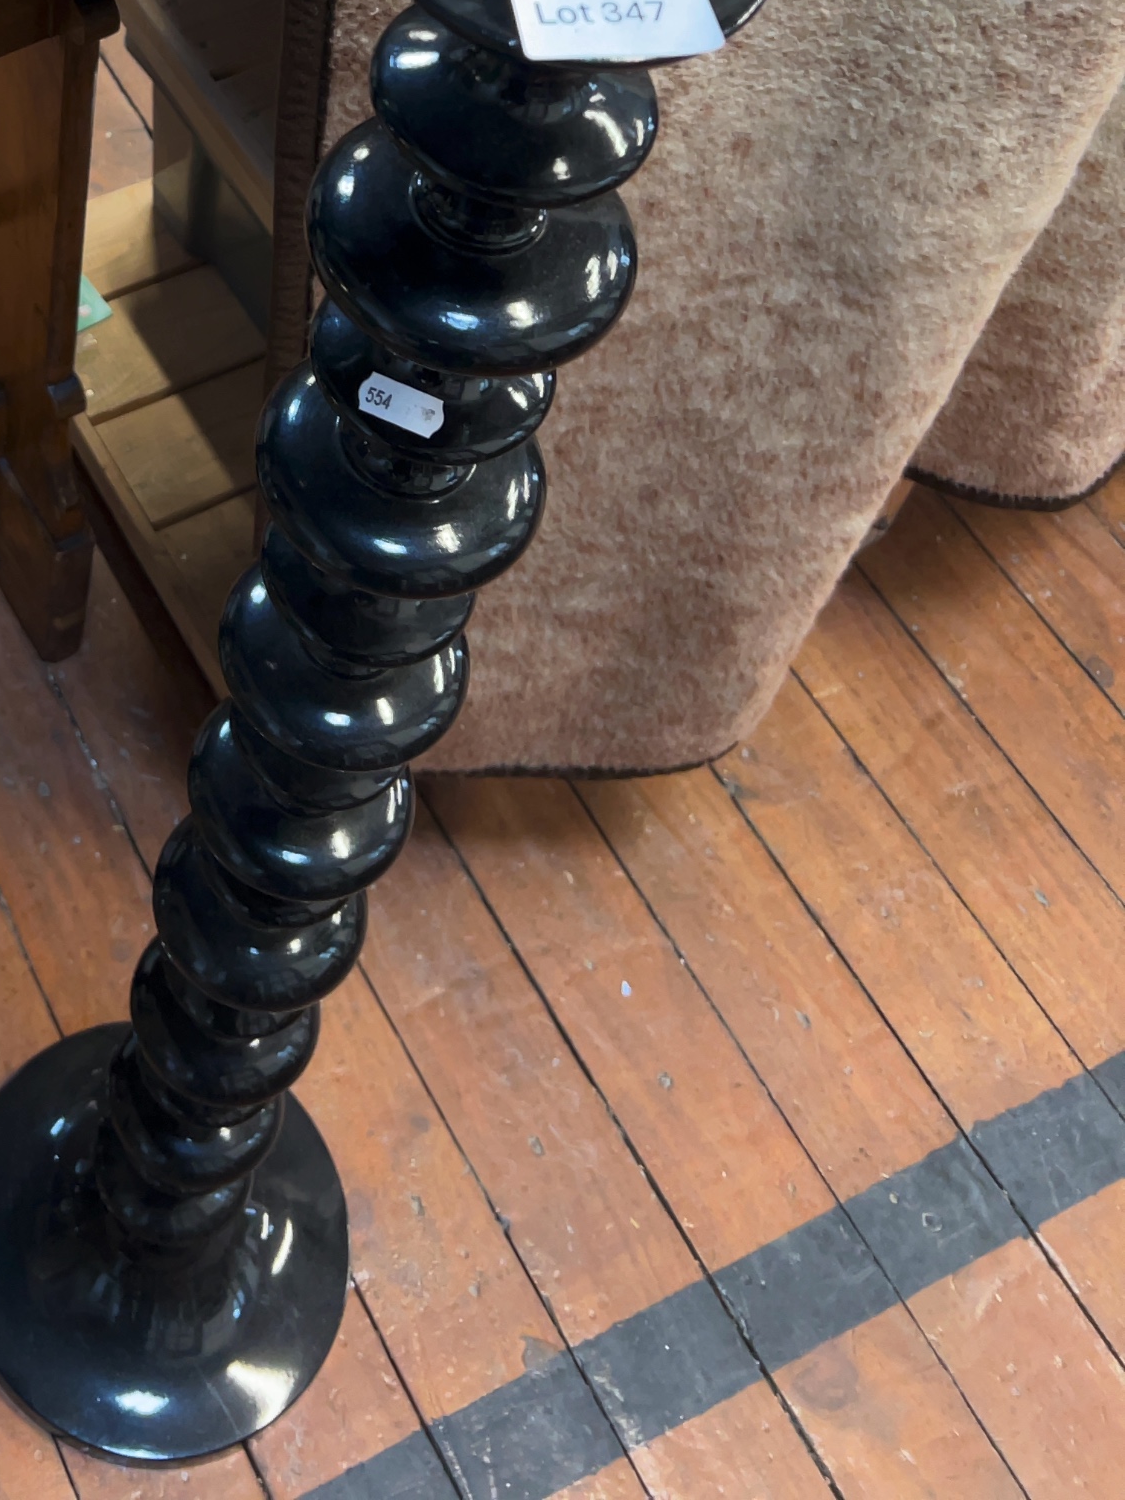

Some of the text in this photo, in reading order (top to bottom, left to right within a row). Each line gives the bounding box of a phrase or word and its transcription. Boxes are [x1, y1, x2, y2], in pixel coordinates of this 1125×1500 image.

[534, 0, 664, 26] Lot 347
[364, 386, 393, 410] 554
